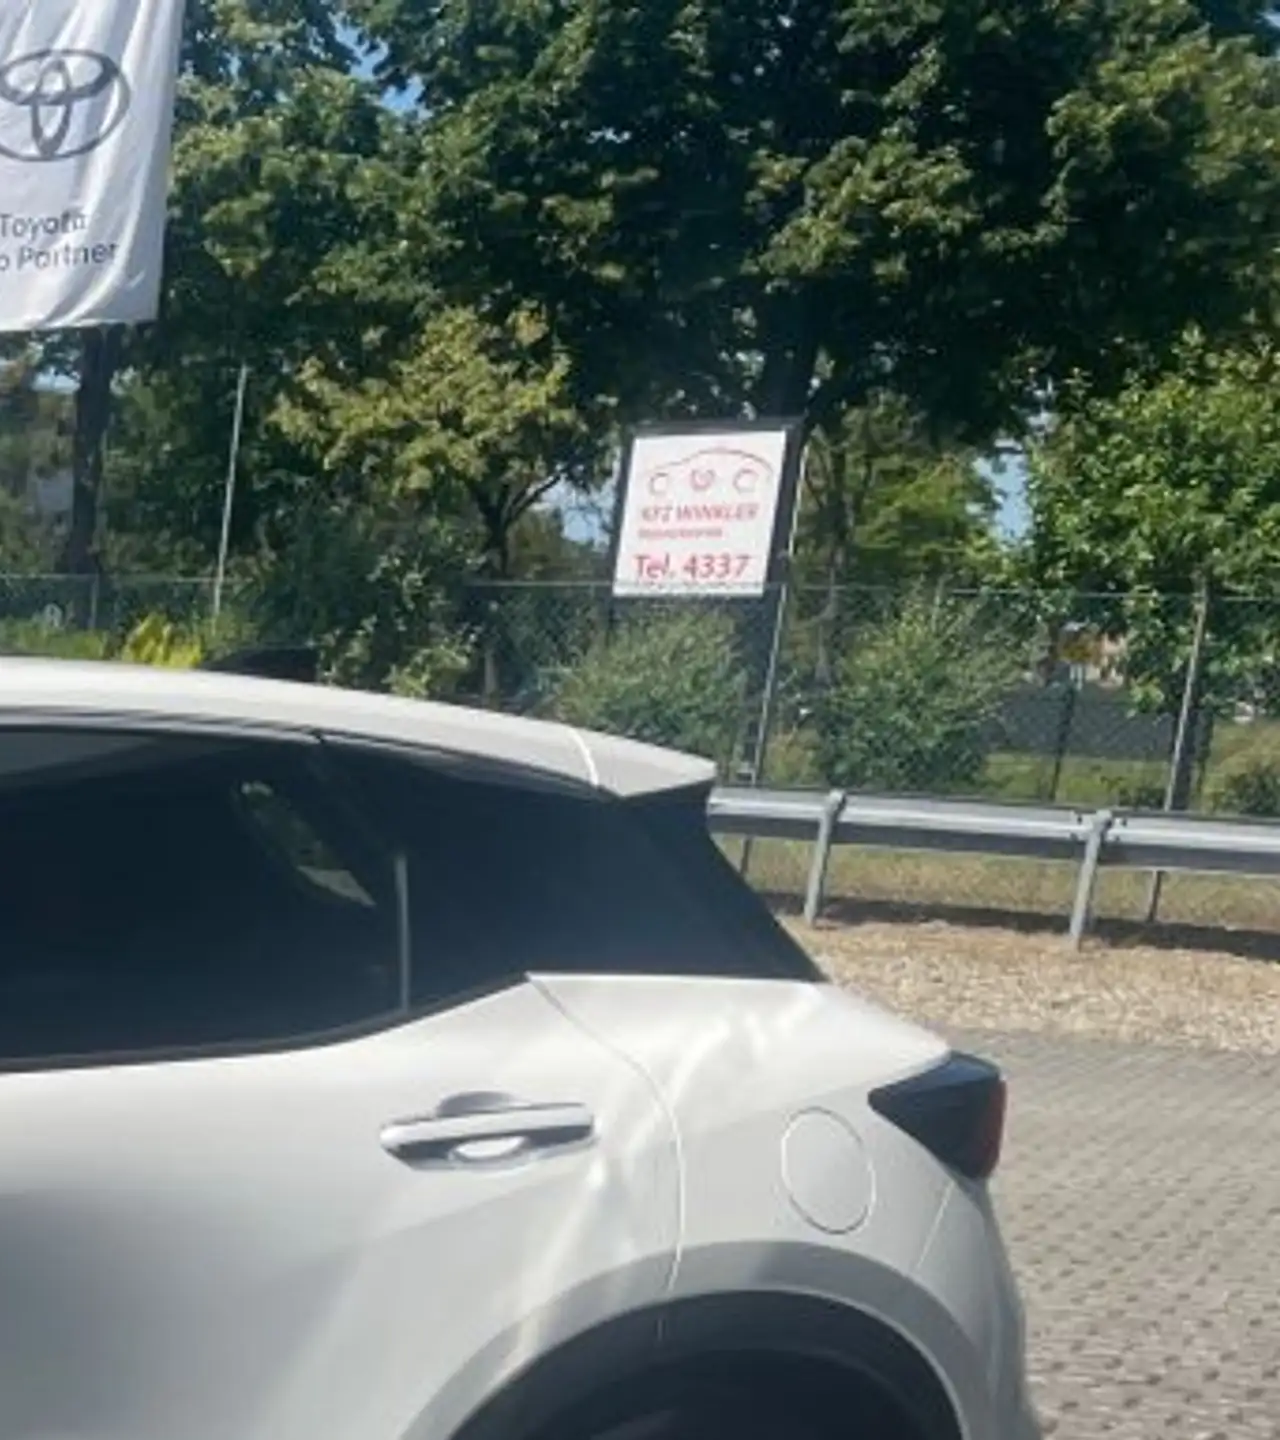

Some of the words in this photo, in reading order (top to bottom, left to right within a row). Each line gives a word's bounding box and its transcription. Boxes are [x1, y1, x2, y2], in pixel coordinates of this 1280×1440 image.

[16, 241, 120, 271] Partner
[634, 553, 676, 580] Tel.
[683, 552, 752, 579] 4337
